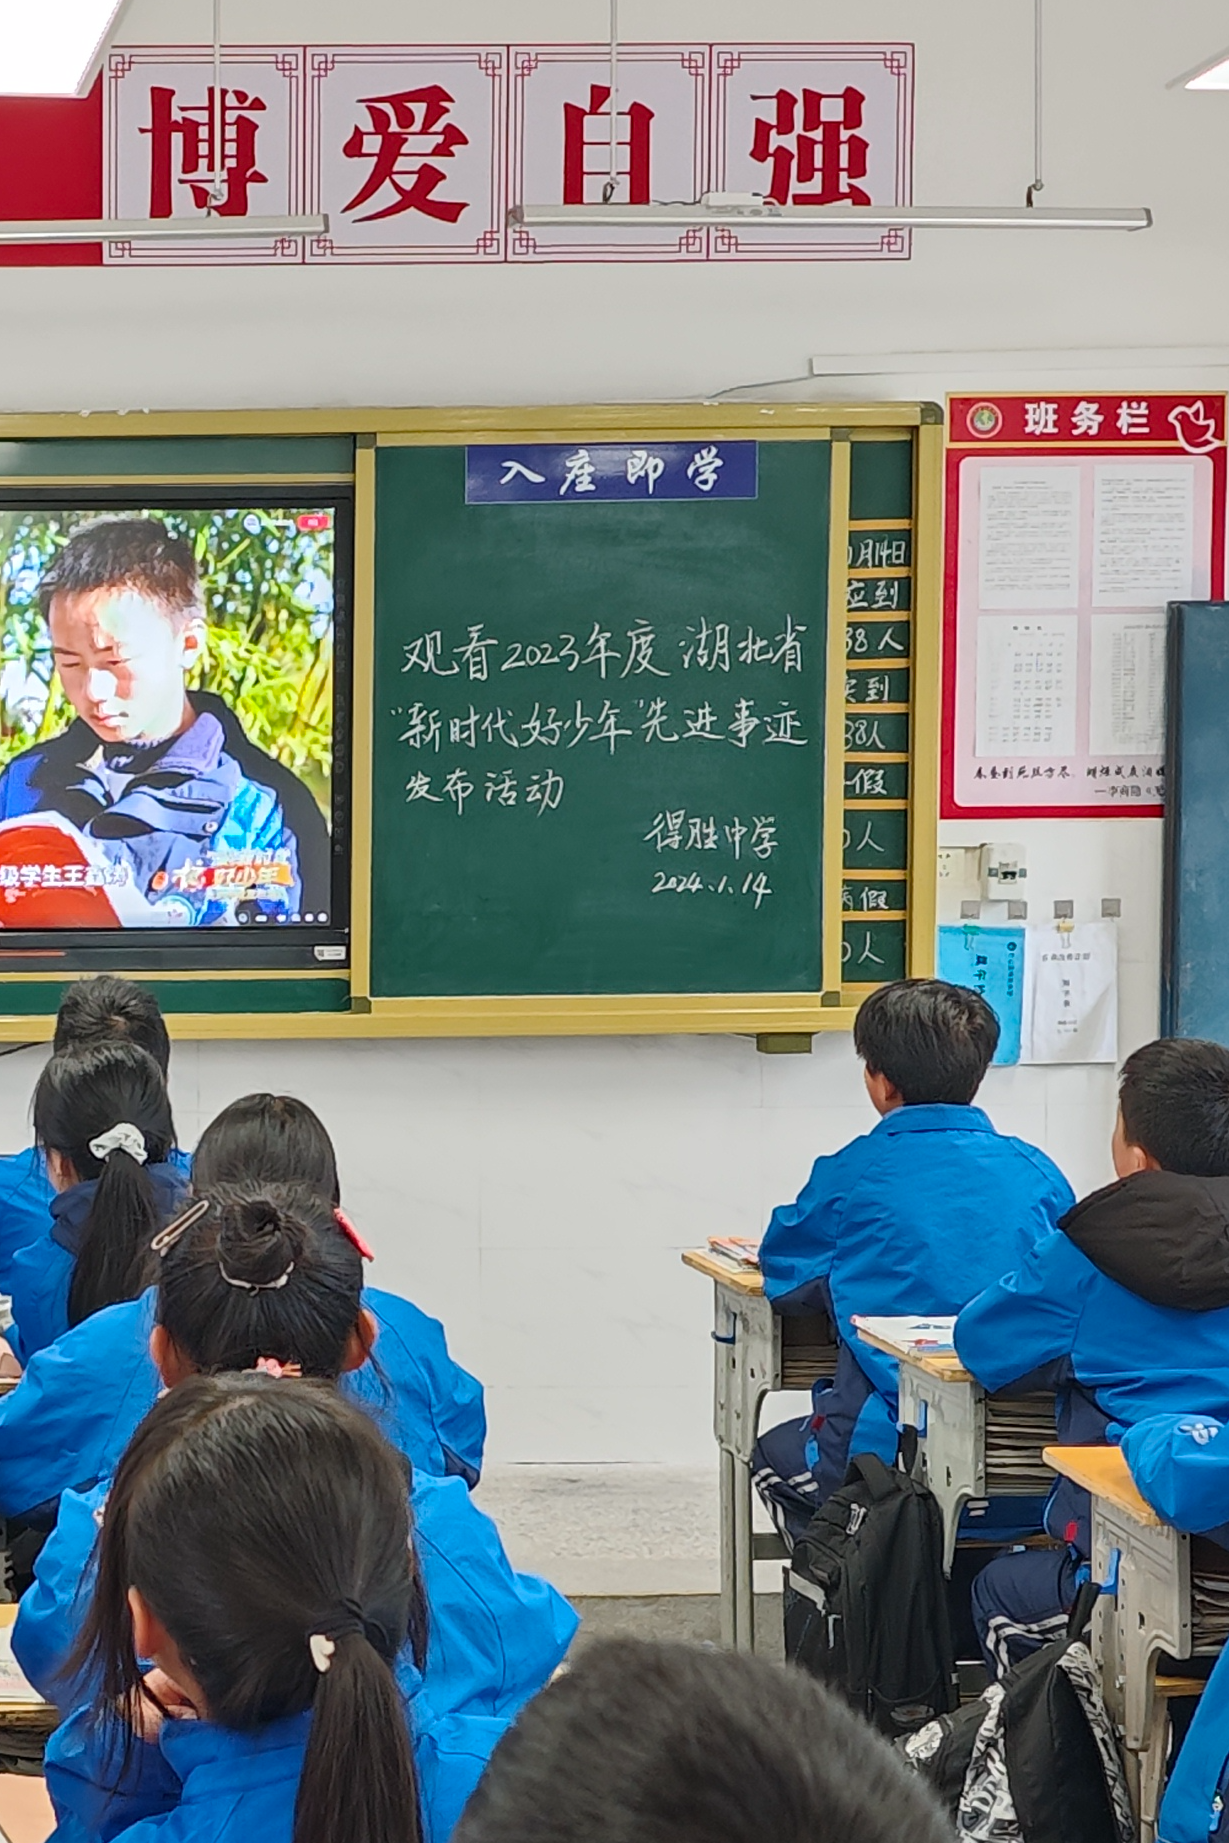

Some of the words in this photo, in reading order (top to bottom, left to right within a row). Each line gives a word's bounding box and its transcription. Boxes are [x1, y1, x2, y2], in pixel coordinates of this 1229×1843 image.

[139, 85, 870, 224] 博爱自强
[1024, 401, 1150, 435] 班务栏
[500, 446, 724, 495] 入座即学
[405, 767, 564, 817] 发布活动
[844, 768, 887, 795] 假
[643, 810, 778, 860] 得胜中学
